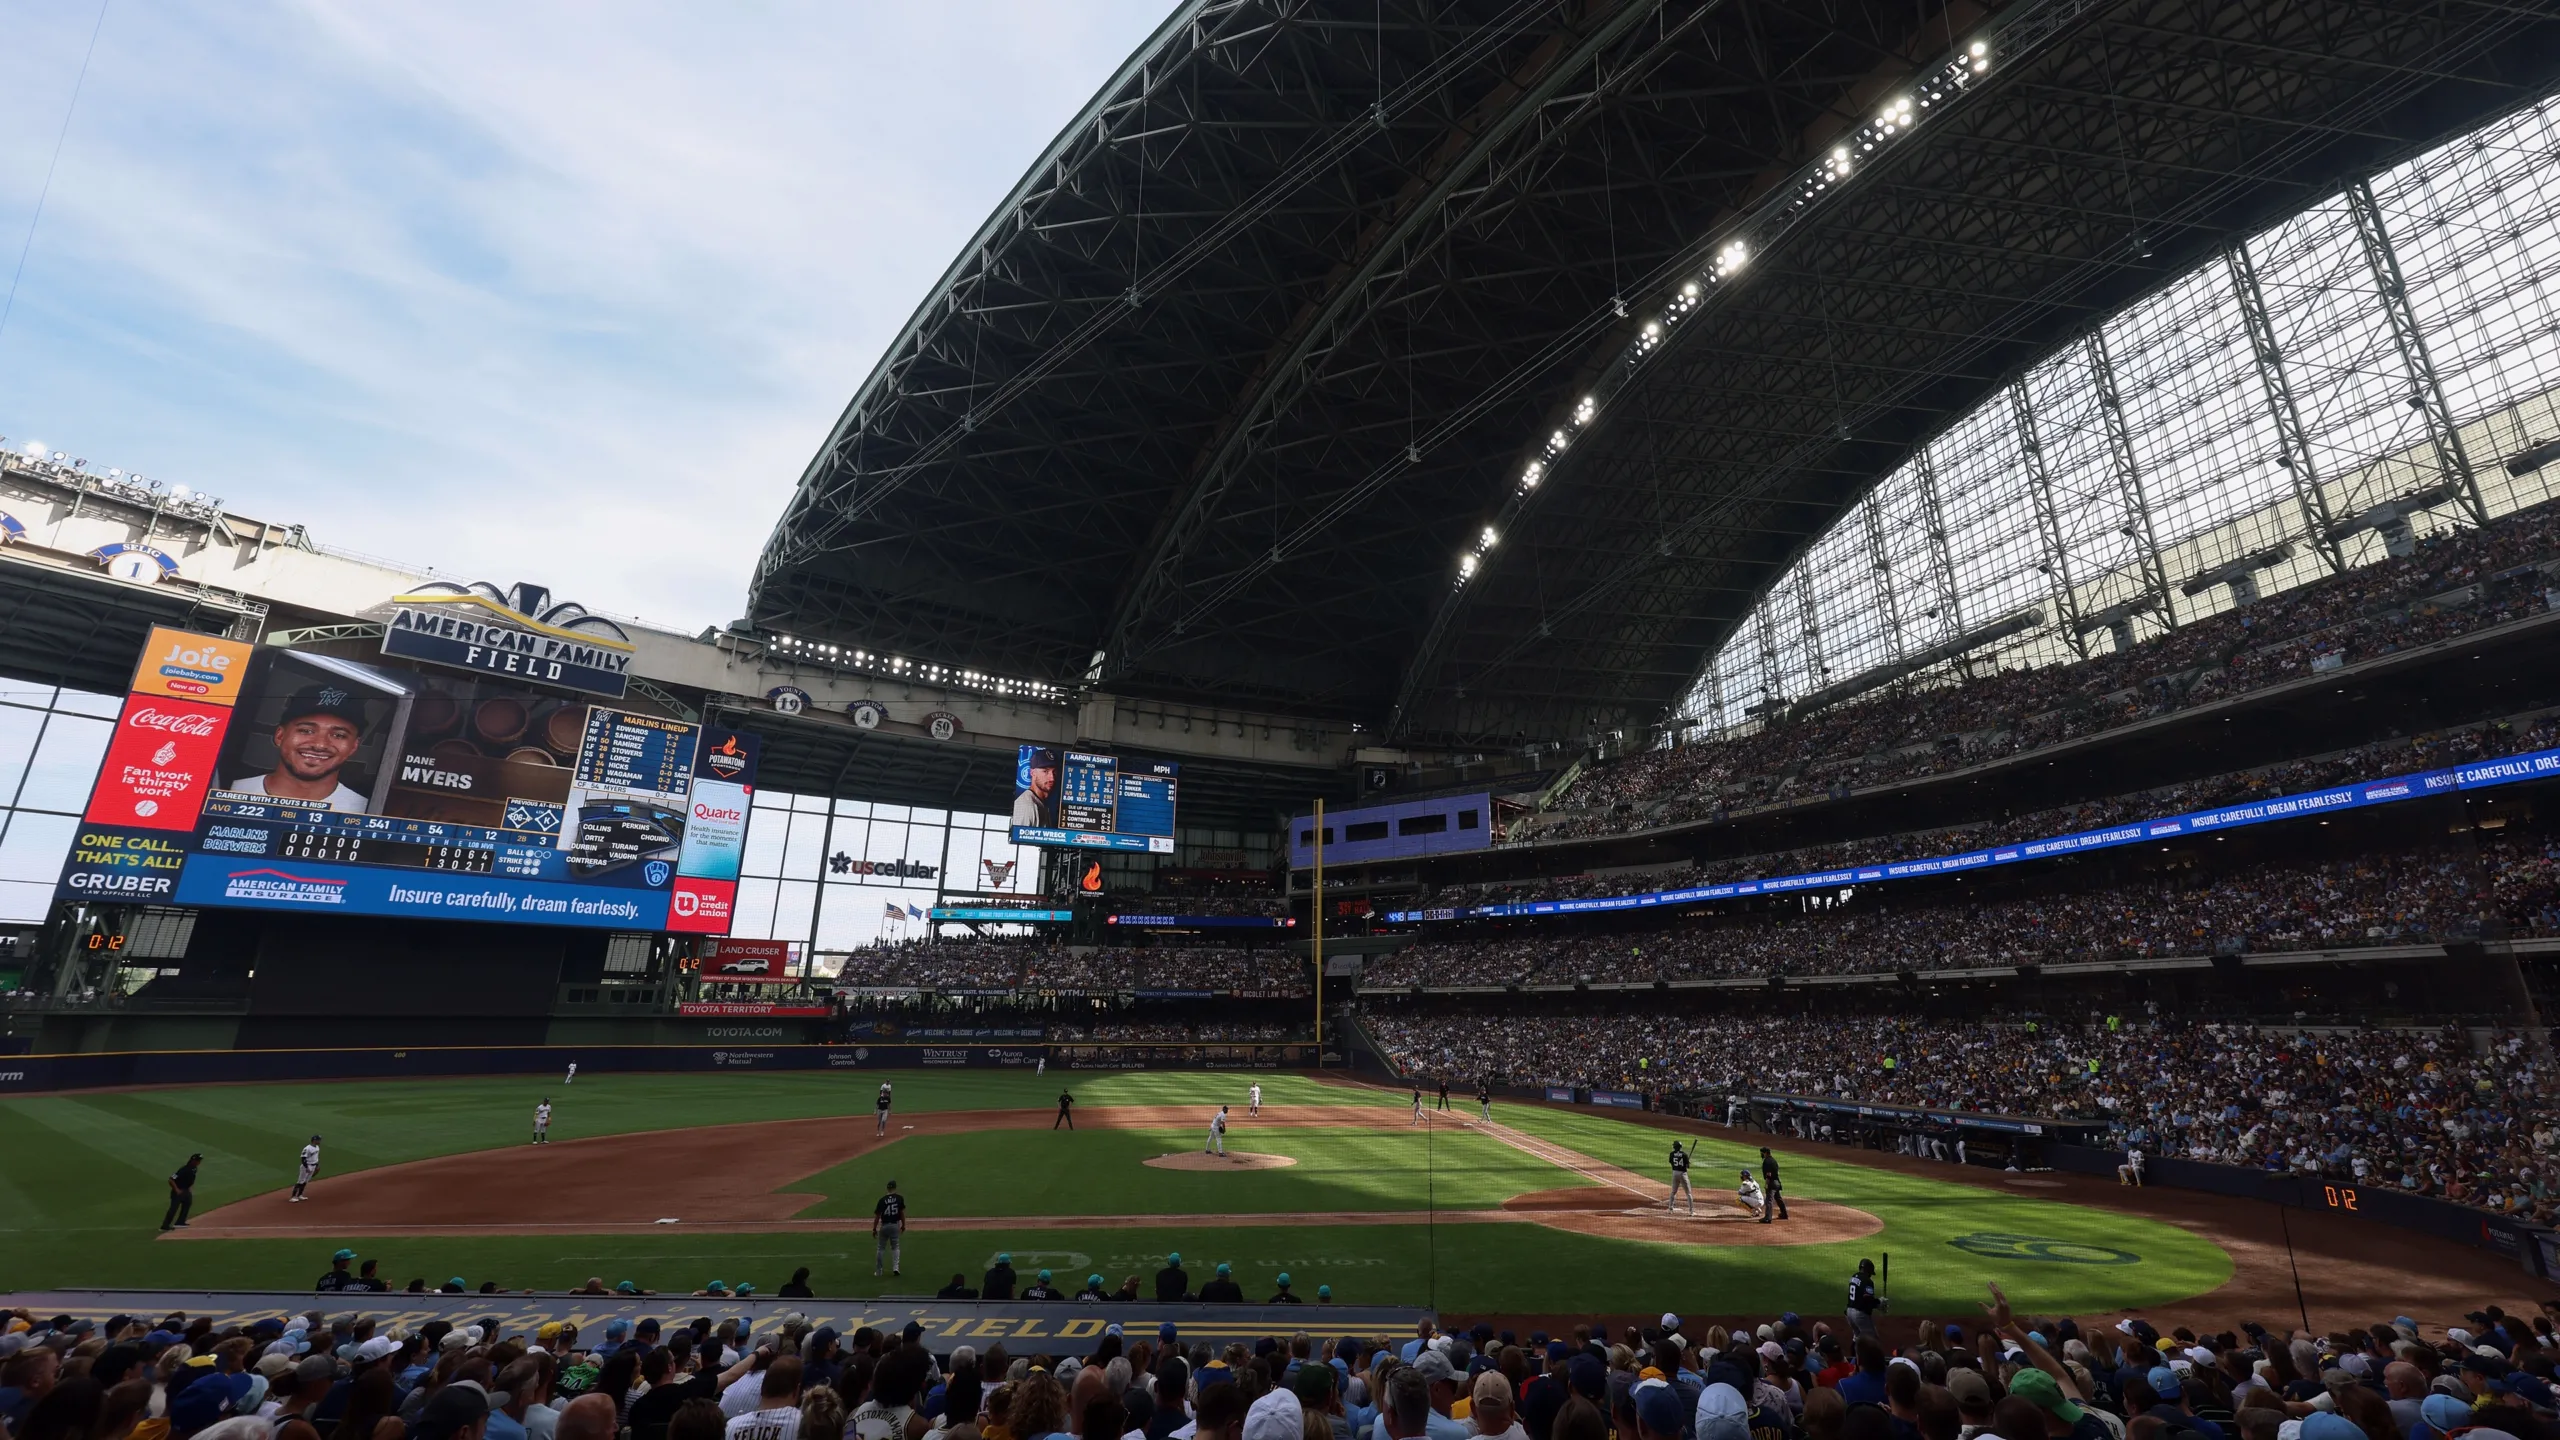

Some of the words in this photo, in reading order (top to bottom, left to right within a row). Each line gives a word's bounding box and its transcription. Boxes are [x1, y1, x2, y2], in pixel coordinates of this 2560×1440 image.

[122, 543, 161, 557] SELIG
[128, 562, 141, 578] 1
[392, 609, 536, 654] AMERICAN
[543, 640, 631, 672] FAMILY
[164, 645, 230, 670] Joie
[466, 646, 562, 680] FIELD
[165, 667, 218, 681] joiebaby.com
[170, 682, 187, 690] Now
[778, 686, 803, 696] YOUNT
[779, 697, 799, 711] 19
[853, 700, 884, 712] MOLITOR
[129, 708, 221, 736] Coca-Cola
[861, 711, 872, 724] 4
[624, 716, 660, 728] MARLINS
[661, 722, 689, 733] LINEUP
[935, 721, 950, 732] 50
[616, 725, 649, 736] EDWARDS
[613, 739, 643, 750] RAMÍREZ
[611, 747, 643, 757] STOWERS
[406, 755, 436, 766] DANE
[709, 754, 746, 768] POTAWATOMI
[1069, 754, 1091, 762] AARON
[1092, 756, 1112, 764] ASHBY
[608, 762, 629, 770] HICKS
[1154, 765, 1170, 774] MPH
[123, 766, 151, 777] Fan
[155, 770, 193, 781] work
[401, 766, 473, 790] MYERS
[607, 769, 643, 780] WAGAMAN
[2424, 772, 2465, 789] INSURE
[2467, 761, 2534, 782] CAREFULLY,
[122, 774, 135, 784] is
[139, 777, 189, 790] thirsty
[605, 777, 631, 786] PAULEY
[133, 786, 172, 797] work
[604, 784, 627, 793] MYERS
[215, 791, 249, 801] CAREER
[250, 795, 271, 804] WITH
[279, 798, 301, 806] OUTS
[309, 801, 328, 809] RISP
[1124, 791, 1151, 799] CURVEBALL
[510, 799, 538, 808] PREVIOUS
[538, 802, 563, 810] AT-BATS
[2191, 814, 2220, 828] INSURE
[2220, 807, 2266, 823] CAREFULLY,
[2267, 801, 2298, 814] DREAM
[2298, 791, 2353, 809] FEARLESSLY
[694, 804, 741, 820] Quartz
[210, 803, 231, 813] AVG
[233, 805, 265, 817] .222
[281, 810, 297, 819] RBI
[308, 812, 324, 823] 13
[343, 817, 361, 826] OPS
[364, 818, 390, 829] .541
[428, 825, 443, 835] 54
[485, 831, 497, 840] 12
[539, 836, 547, 845] 3
[582, 823, 612, 833] COLLINS
[621, 822, 650, 831] PERKINS
[208, 825, 268, 840] MARLINS
[712, 828, 739, 836] insurance
[1019, 829, 1041, 837] DON'T
[1042, 830, 1066, 838] WRECK
[81, 834, 124, 848] ONE
[584, 834, 605, 843] ORTIZ
[640, 834, 670, 843] CHOURIO
[203, 838, 267, 853] BREWERS
[571, 842, 598, 852] DURBIN
[611, 842, 639, 851] TURANG
[75, 850, 140, 866] THAT'S
[142, 855, 182, 869] ALL!
[498, 856, 523, 865] STRIKE
[566, 856, 607, 866] CONTRERAS
[609, 851, 638, 861] VAUGHN
[852, 858, 938, 879] uscellular
[988, 866, 1010, 874] VIZZY
[68, 872, 171, 893] GRUBER
[228, 878, 297, 891] AMERICAN
[300, 883, 344, 894] FAMILY
[235, 889, 333, 902] INSURANCE
[388, 884, 442, 905] Insure
[446, 891, 517, 912] carefully,
[521, 894, 568, 912] dream
[570, 897, 639, 920] fearlessly.
[701, 900, 728, 910] credit
[699, 909, 728, 918] union
[89, 934, 125, 950] 0:12
[720, 946, 744, 955] LAND
[745, 947, 780, 956] CRUISER
[680, 957, 700, 970] 0:12
[1039, 989, 1056, 997] 620
[1057, 989, 1085, 997] WTMJ
[683, 1005, 720, 1013] TOYOTA
[722, 1005, 773, 1014] TERRITORY
[707, 1027, 783, 1037] TOYOTA.COM
[828, 1053, 852, 1061] Johnson
[923, 1049, 968, 1057] WINTRUST
[1673, 1158, 1684, 1167] 54
[884, 1203, 898, 1216] 45
[929, 1318, 1109, 1338] FIELD
